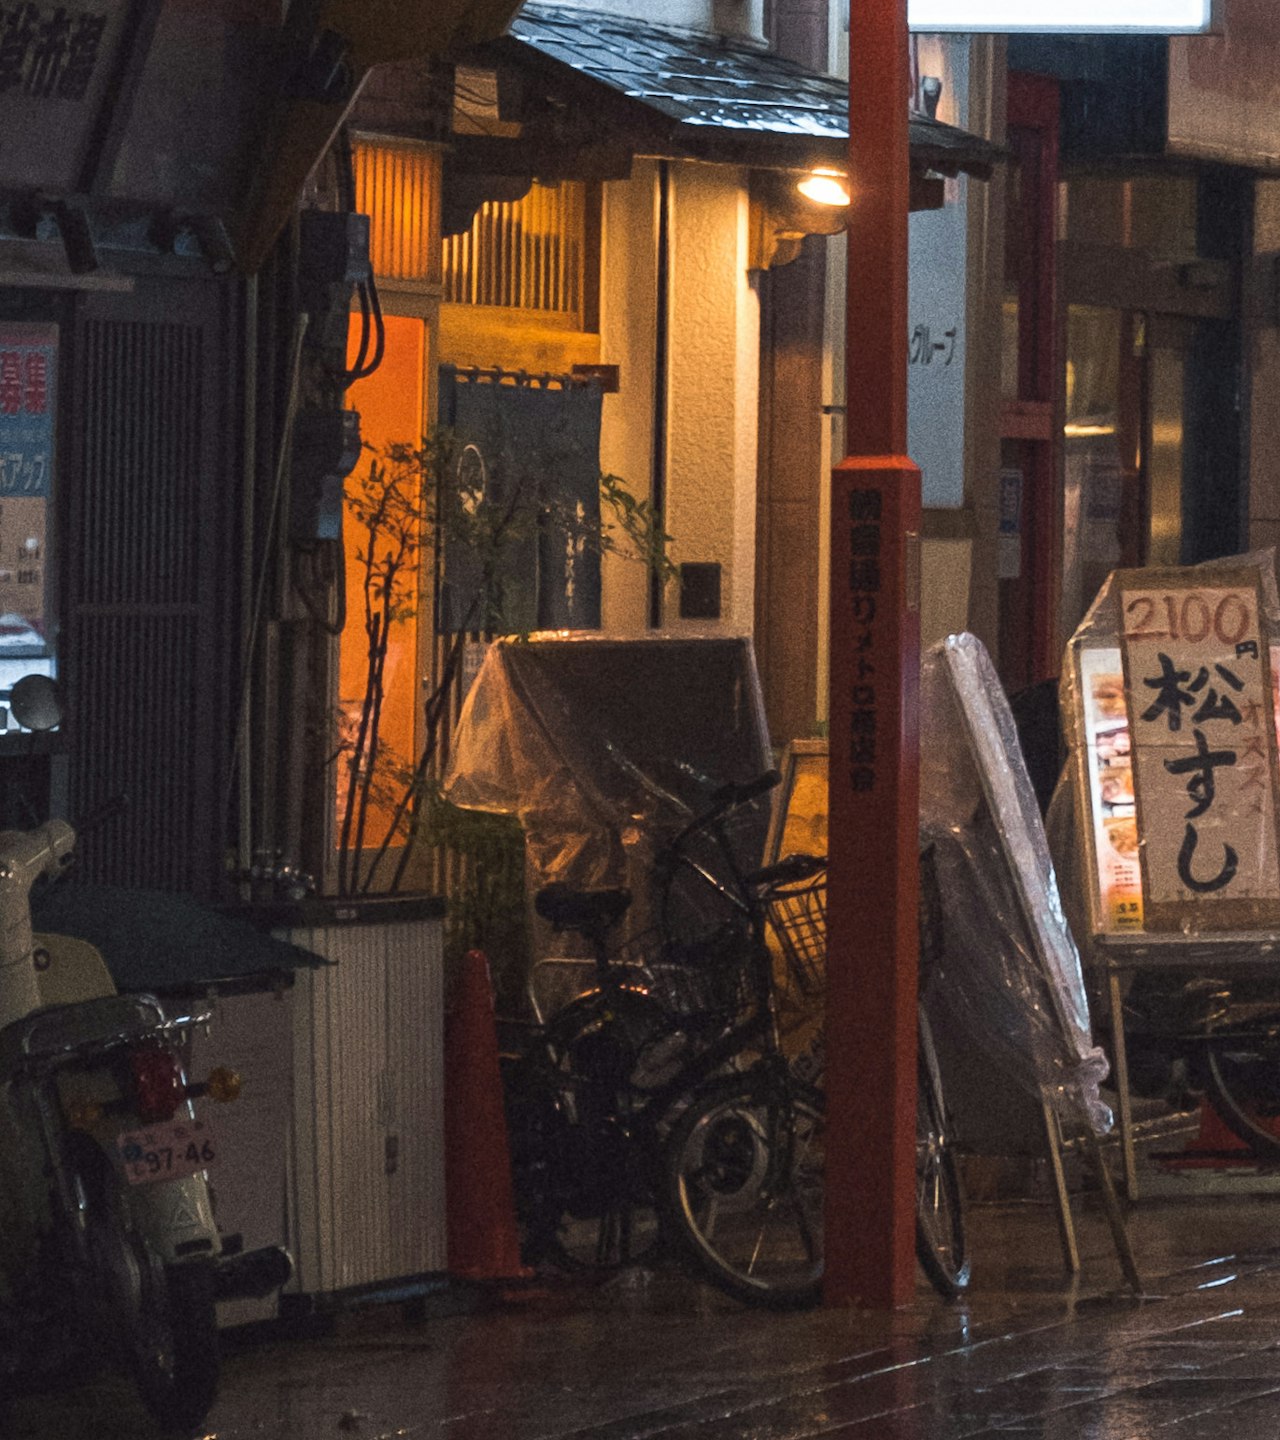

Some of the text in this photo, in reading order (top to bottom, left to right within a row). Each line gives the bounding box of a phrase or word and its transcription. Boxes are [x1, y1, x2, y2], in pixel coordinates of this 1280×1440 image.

[1128, 593, 1250, 644] 2100
[1141, 651, 1245, 894] 松すし
